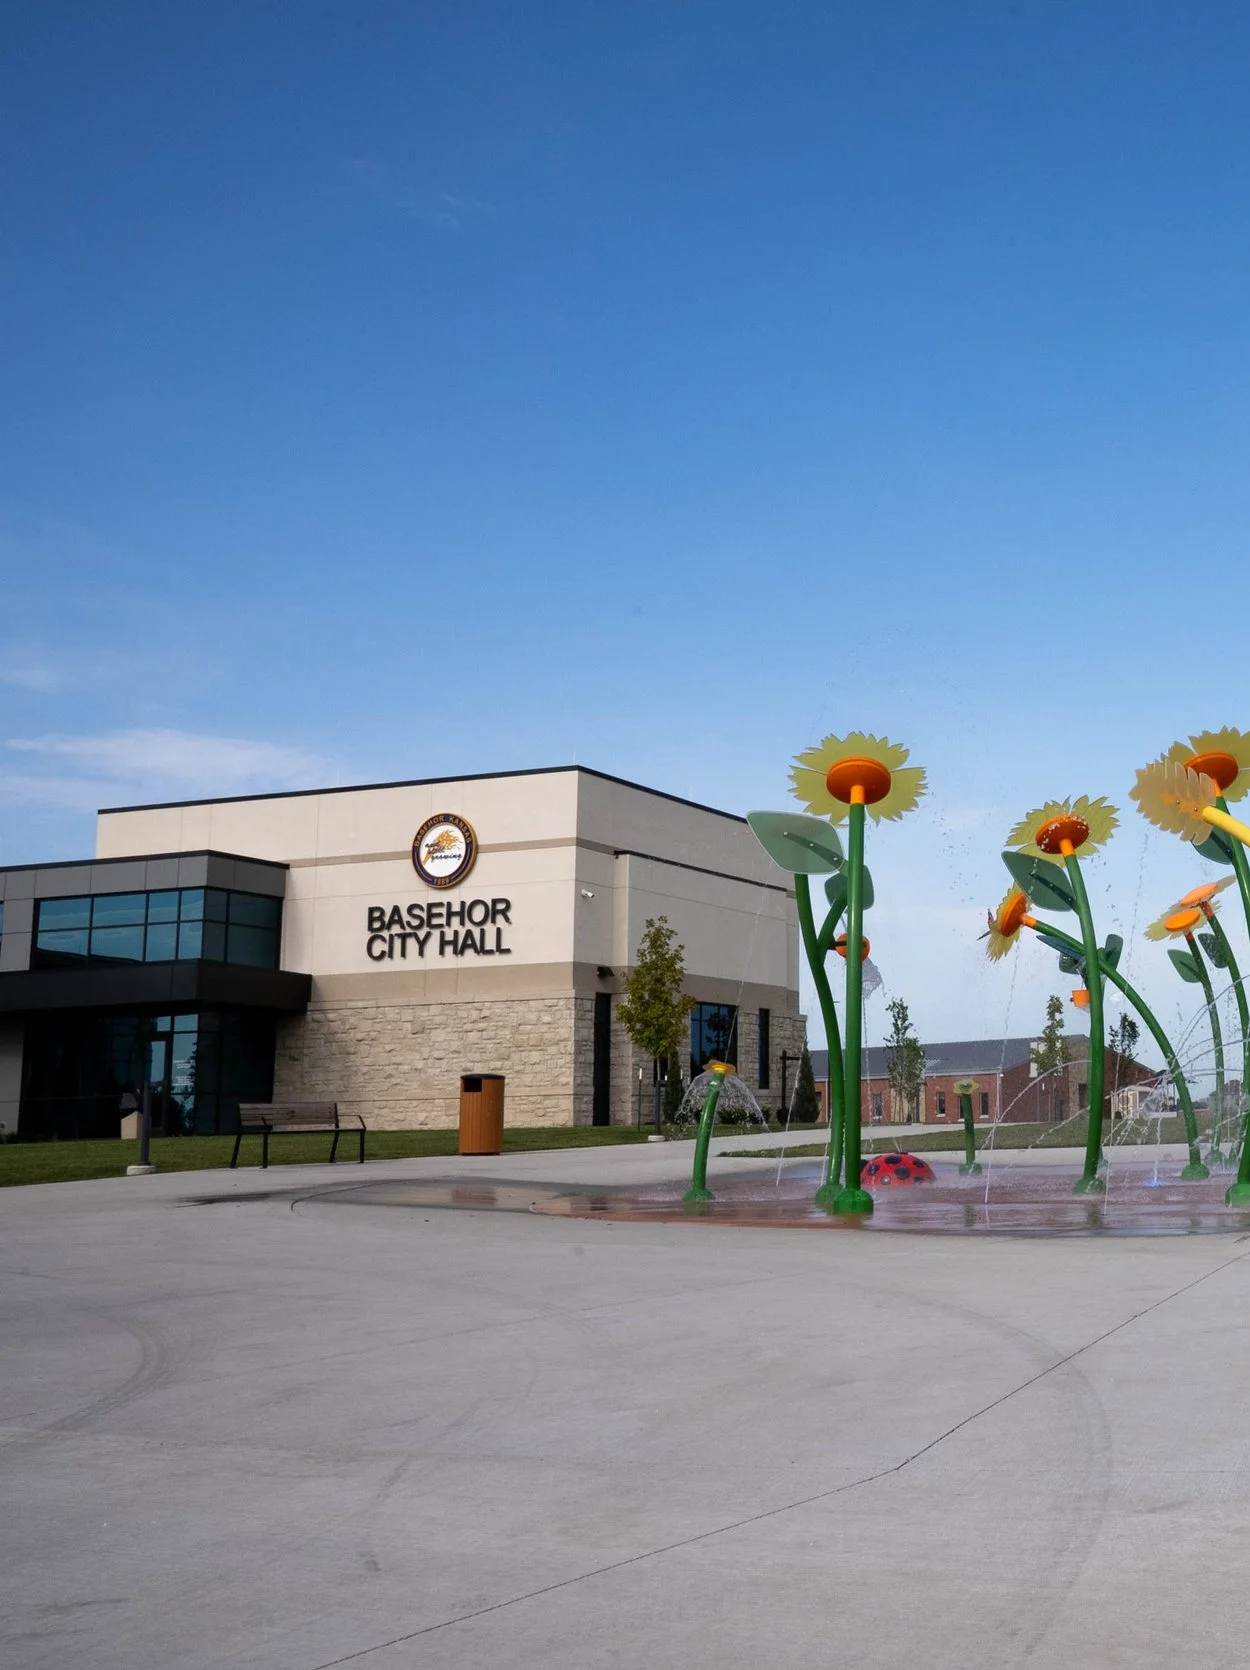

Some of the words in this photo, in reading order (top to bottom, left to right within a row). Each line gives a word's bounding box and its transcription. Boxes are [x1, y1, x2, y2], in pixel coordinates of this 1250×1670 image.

[414, 815, 445, 847] BASEHOR
[449, 815, 472, 843] KANSAS
[367, 898, 512, 933] BASEHOR
[366, 930, 432, 962] CITY
[439, 927, 512, 957] HALL
